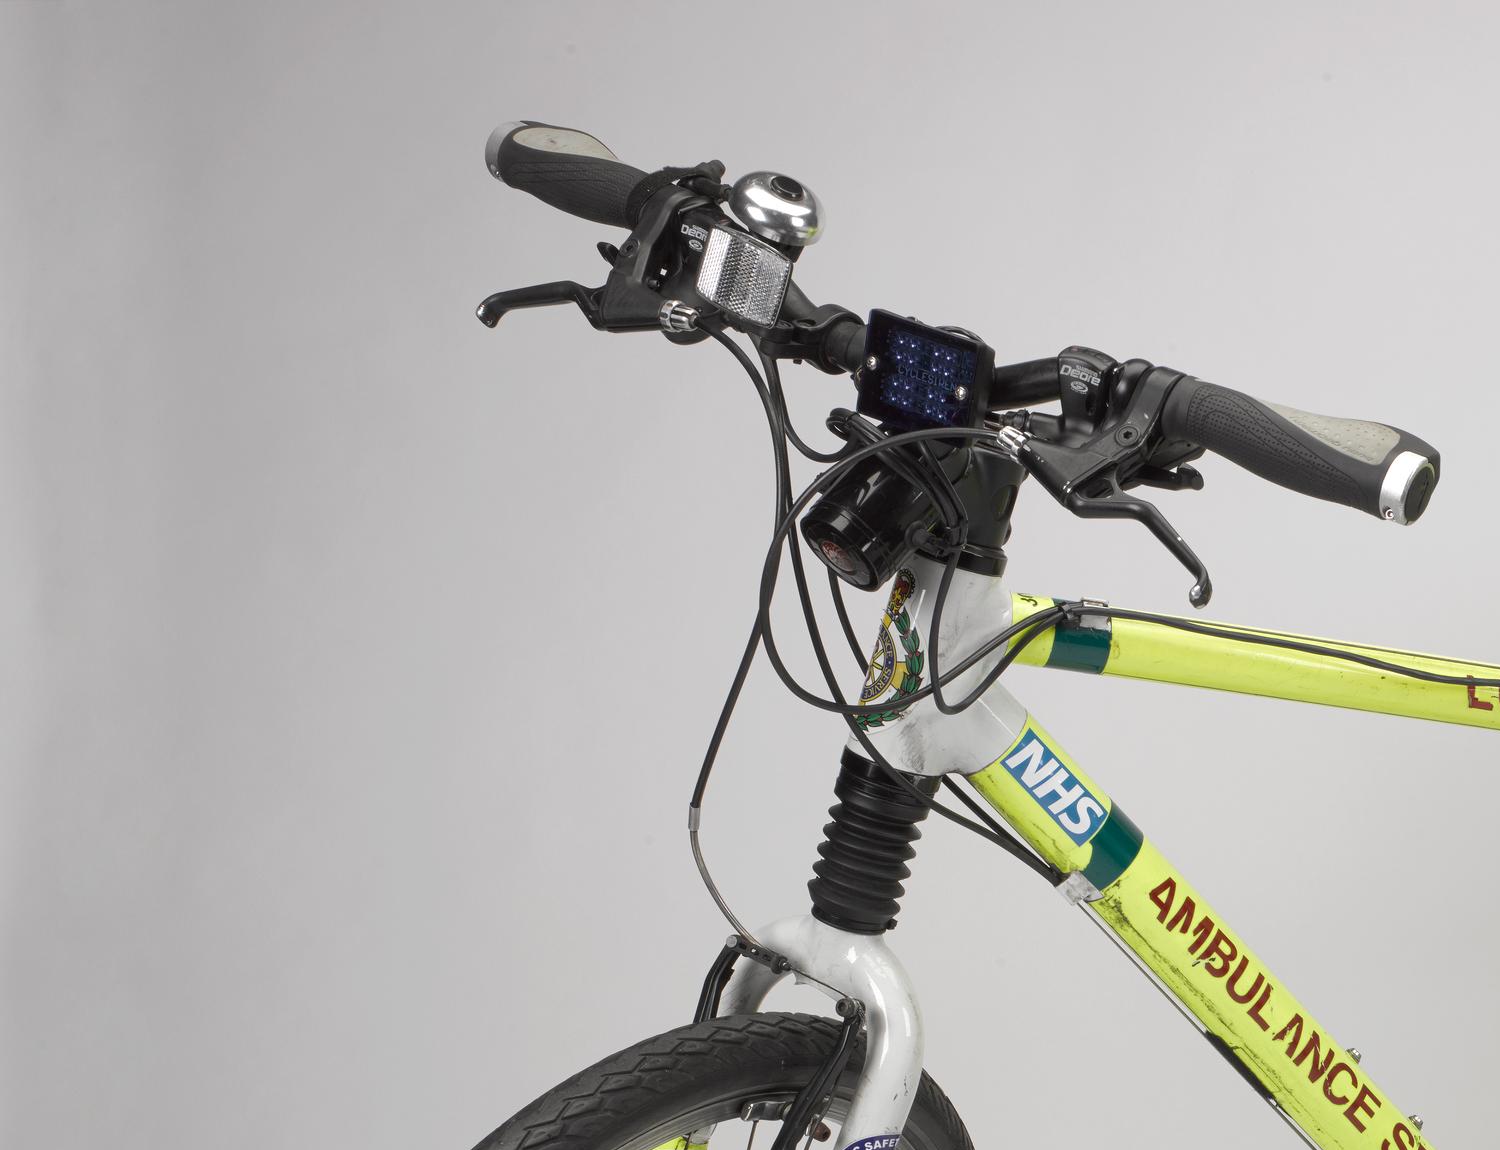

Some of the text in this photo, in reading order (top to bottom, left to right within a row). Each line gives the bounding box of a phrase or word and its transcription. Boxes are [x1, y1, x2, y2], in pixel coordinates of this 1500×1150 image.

[1060, 364, 1101, 387] Deore
[1004, 738, 1104, 835] NHS
[1148, 877, 1382, 1133] AMBULANCE
